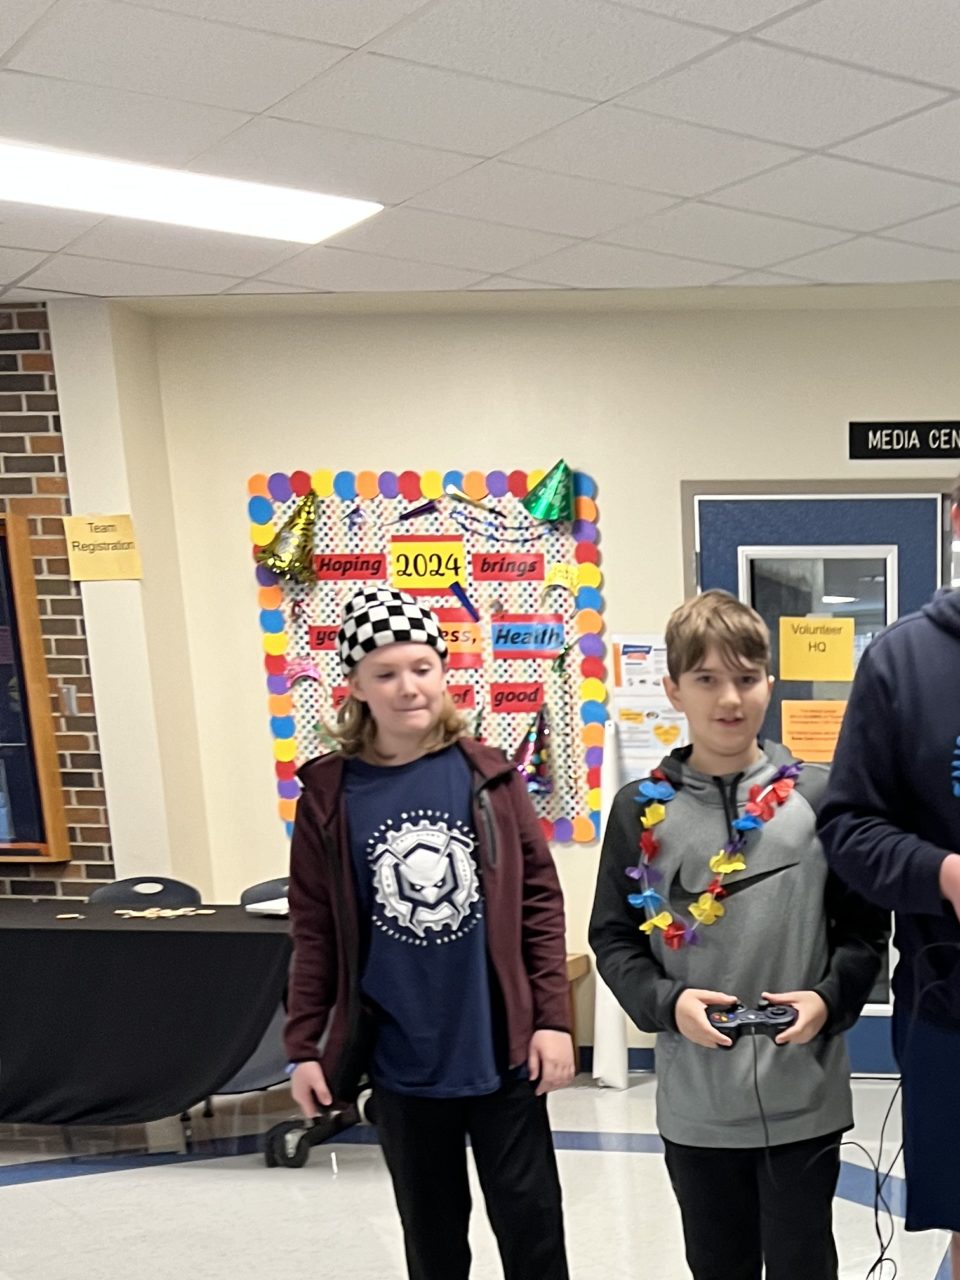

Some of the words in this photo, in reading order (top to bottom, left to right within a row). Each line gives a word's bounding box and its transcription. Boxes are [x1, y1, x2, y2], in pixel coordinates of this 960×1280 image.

[868, 429, 920, 450] MEDIA
[86, 522, 117, 533] Team
[72, 540, 136, 554] Registration
[319, 556, 382, 577] Hoping
[396, 553, 462, 577] 2024
[480, 557, 536, 577] brings
[316, 627, 338, 645] yo
[792, 623, 842, 635] Volunteer
[808, 641, 826, 653] HQ
[494, 686, 540, 704] good
